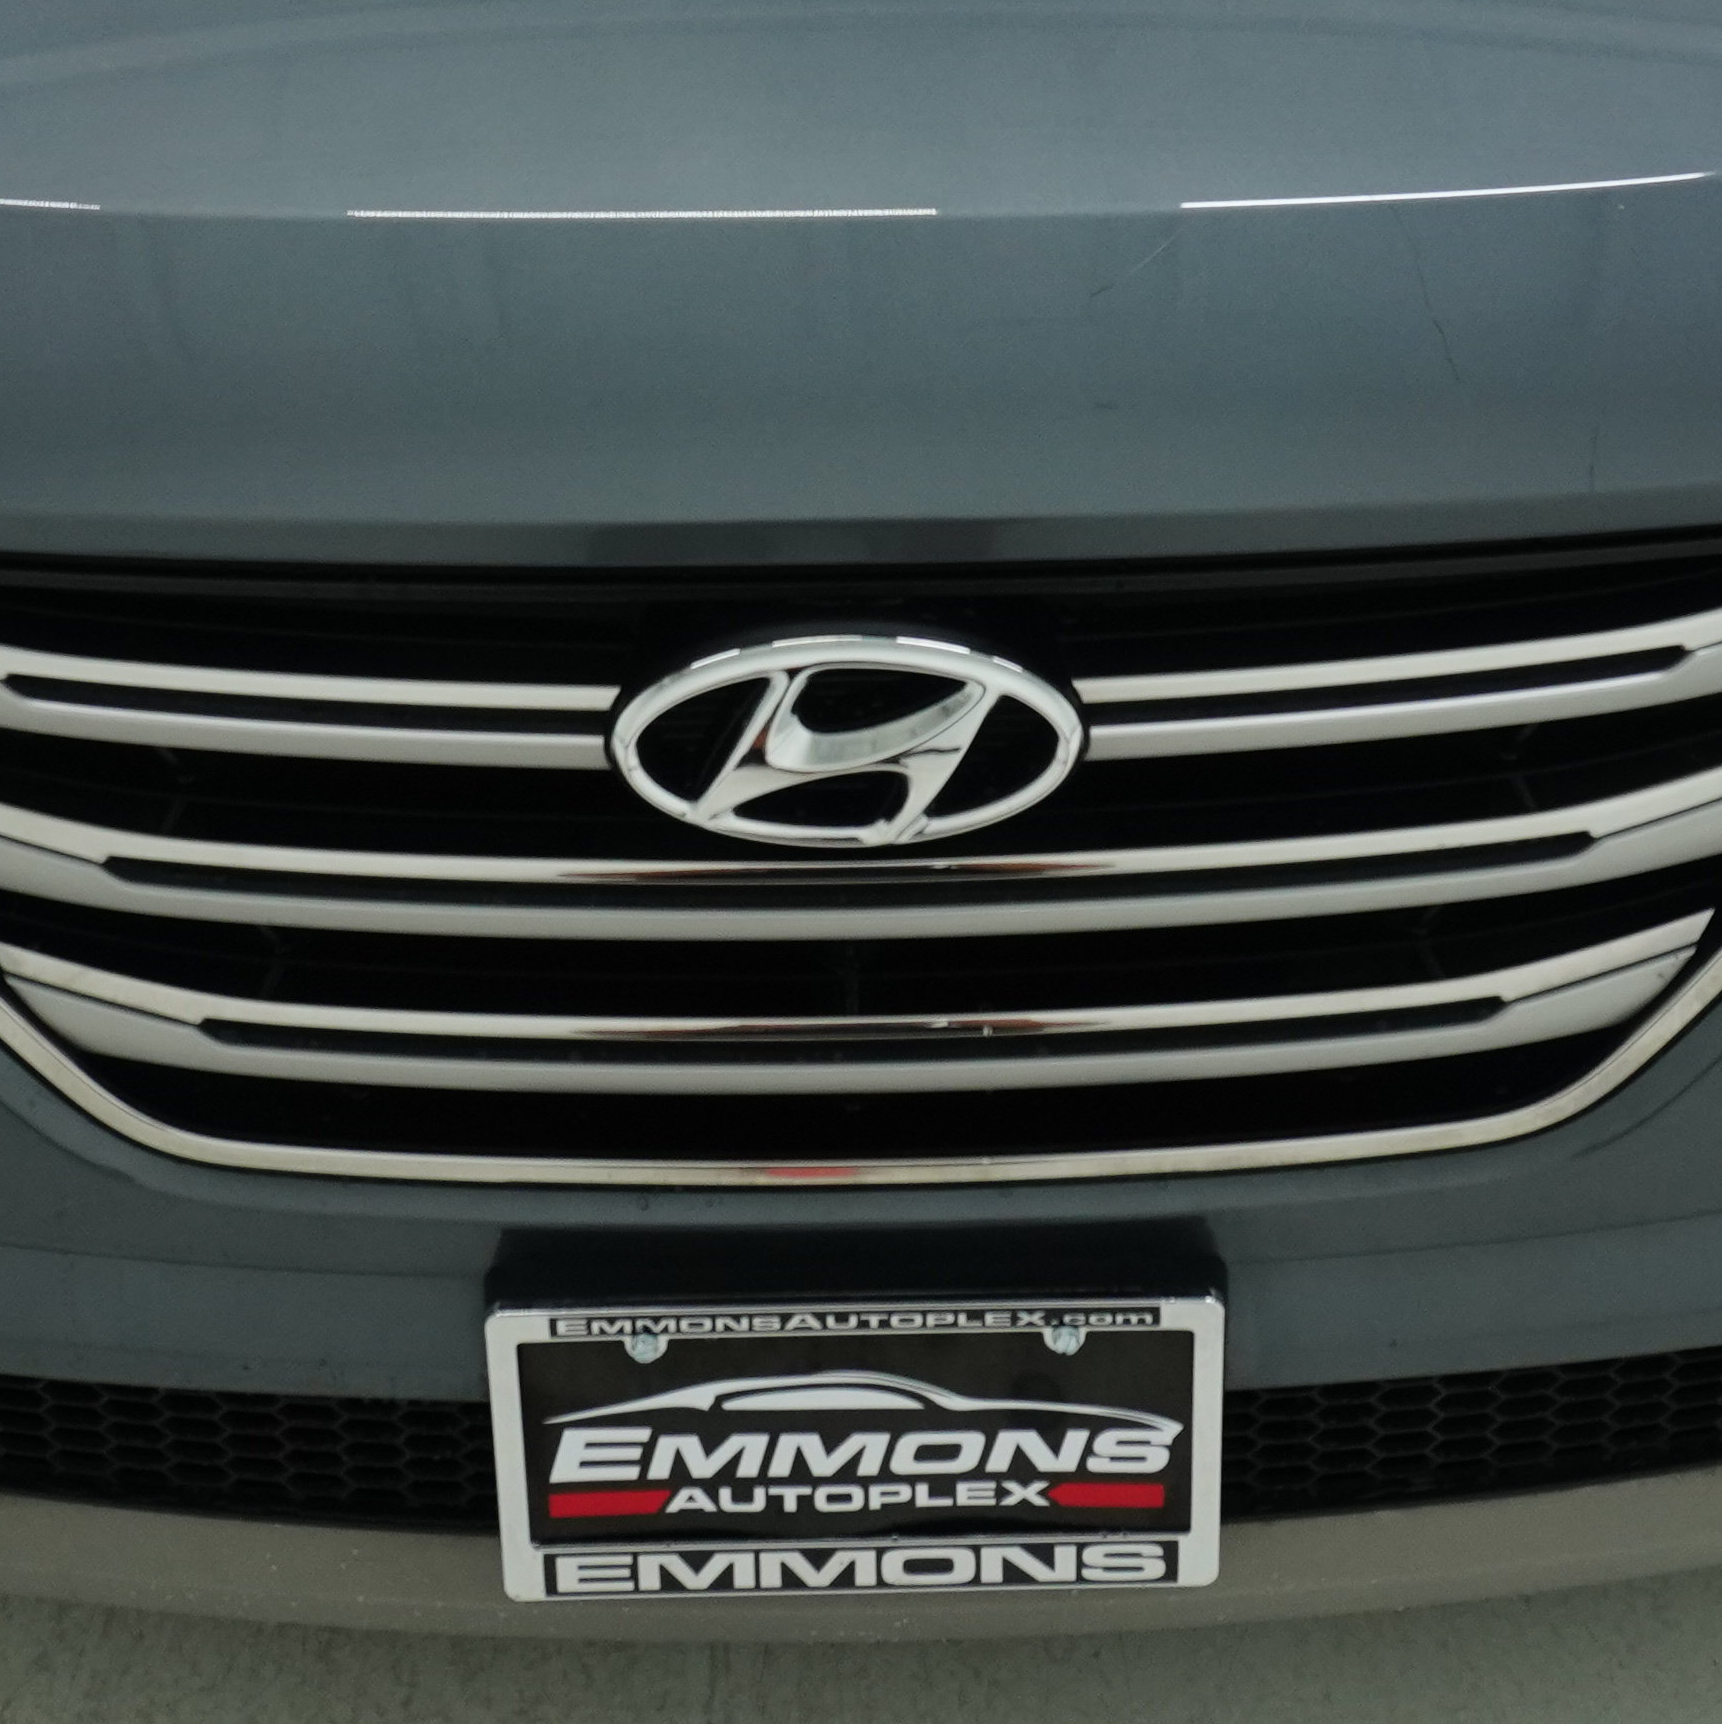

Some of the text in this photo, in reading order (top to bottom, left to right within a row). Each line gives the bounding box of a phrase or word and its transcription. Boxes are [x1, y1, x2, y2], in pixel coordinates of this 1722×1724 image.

[549, 1426, 1172, 1484] EMMONS
[665, 1480, 1050, 1514] AUTOPLEX
[554, 1542, 1167, 1594] EMMONS
